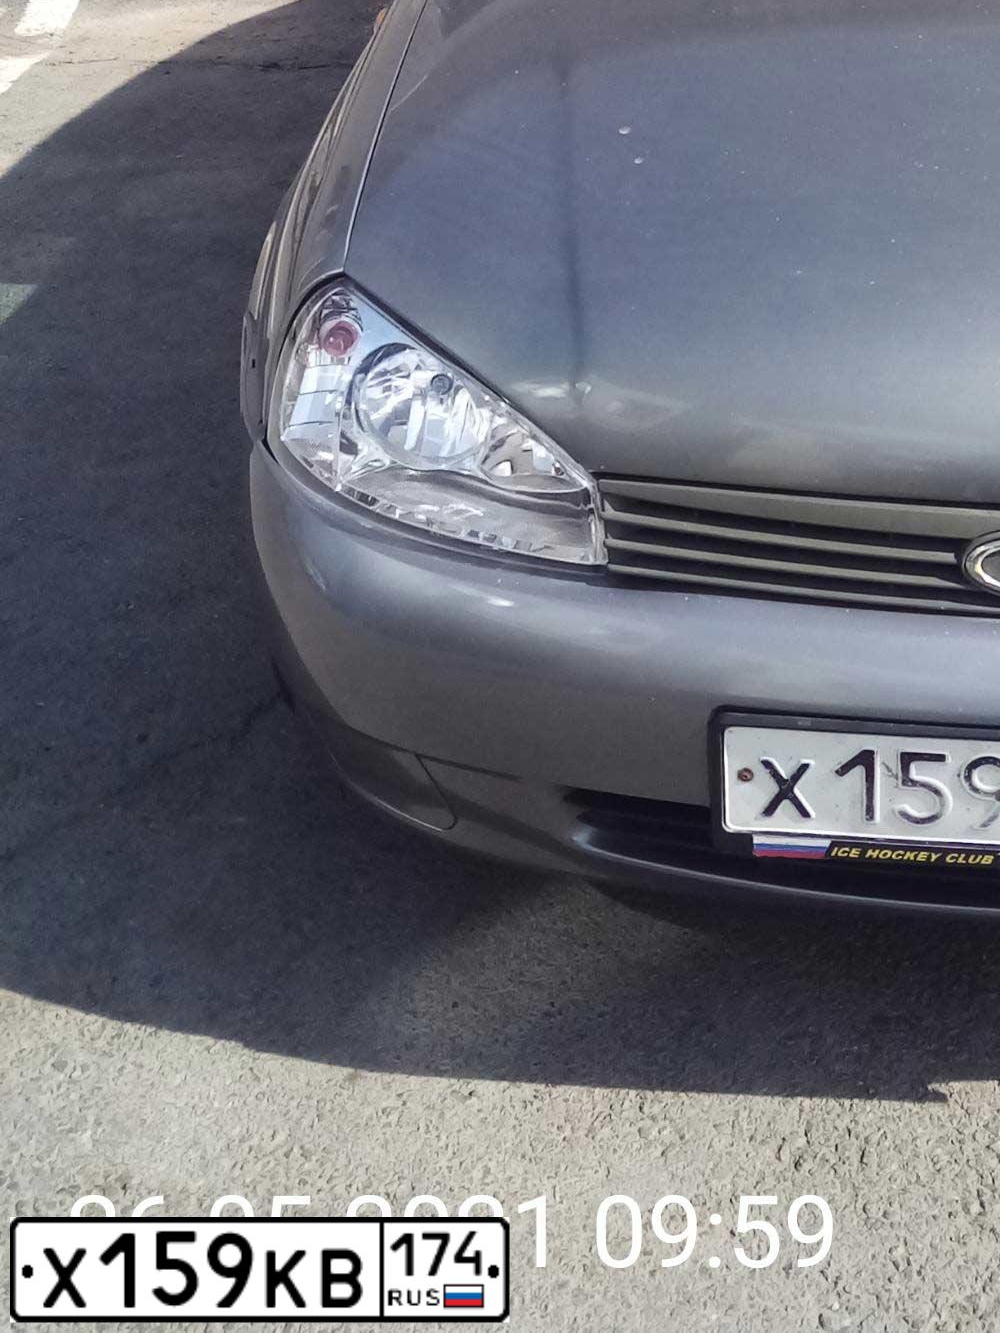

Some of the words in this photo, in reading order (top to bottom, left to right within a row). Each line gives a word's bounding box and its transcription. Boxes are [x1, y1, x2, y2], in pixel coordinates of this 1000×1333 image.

[830, 846, 862, 858] ICE
[865, 848, 943, 863] HOCKEY
[945, 852, 997, 866] CLUB
